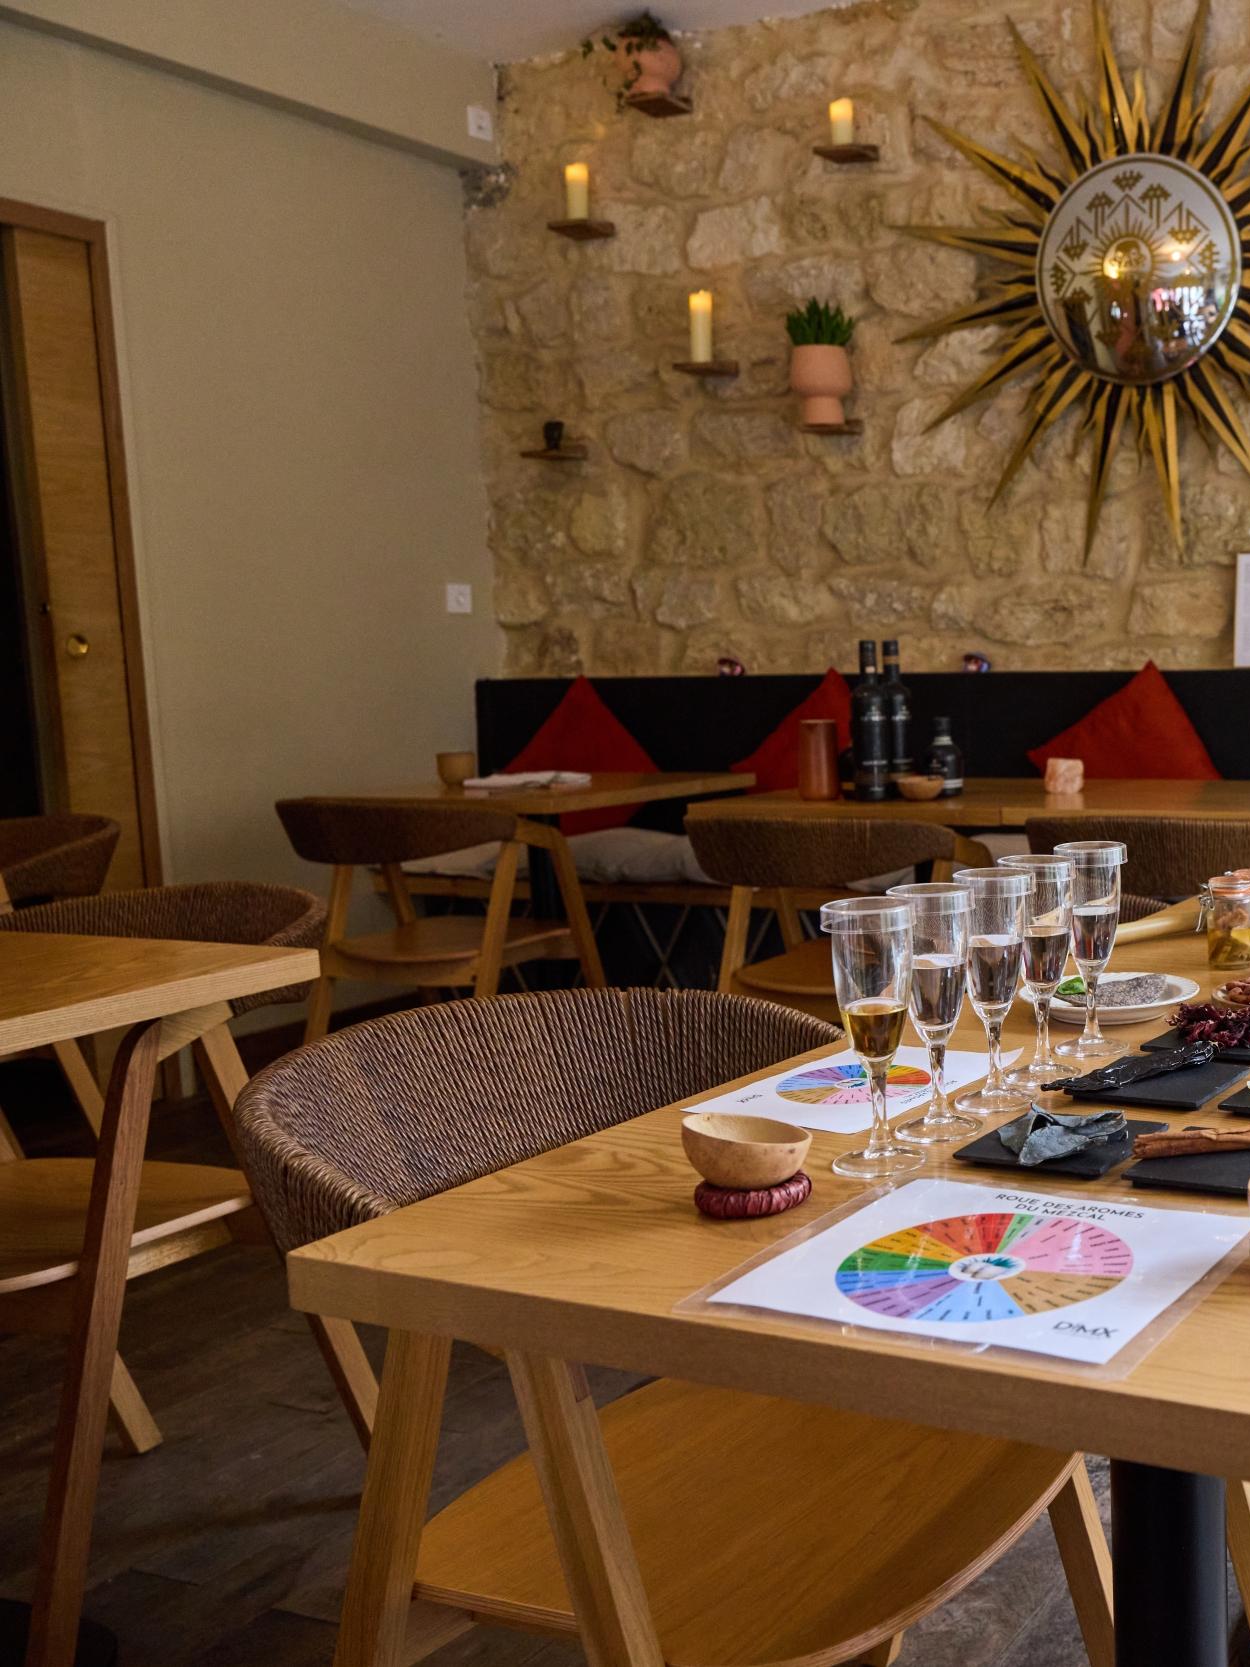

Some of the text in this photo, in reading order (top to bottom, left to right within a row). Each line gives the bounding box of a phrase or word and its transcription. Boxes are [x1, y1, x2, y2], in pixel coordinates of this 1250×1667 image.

[995, 1193, 1145, 1219] ROUE DES AROMES
[1014, 1203, 1105, 1221] DU MEZCAL
